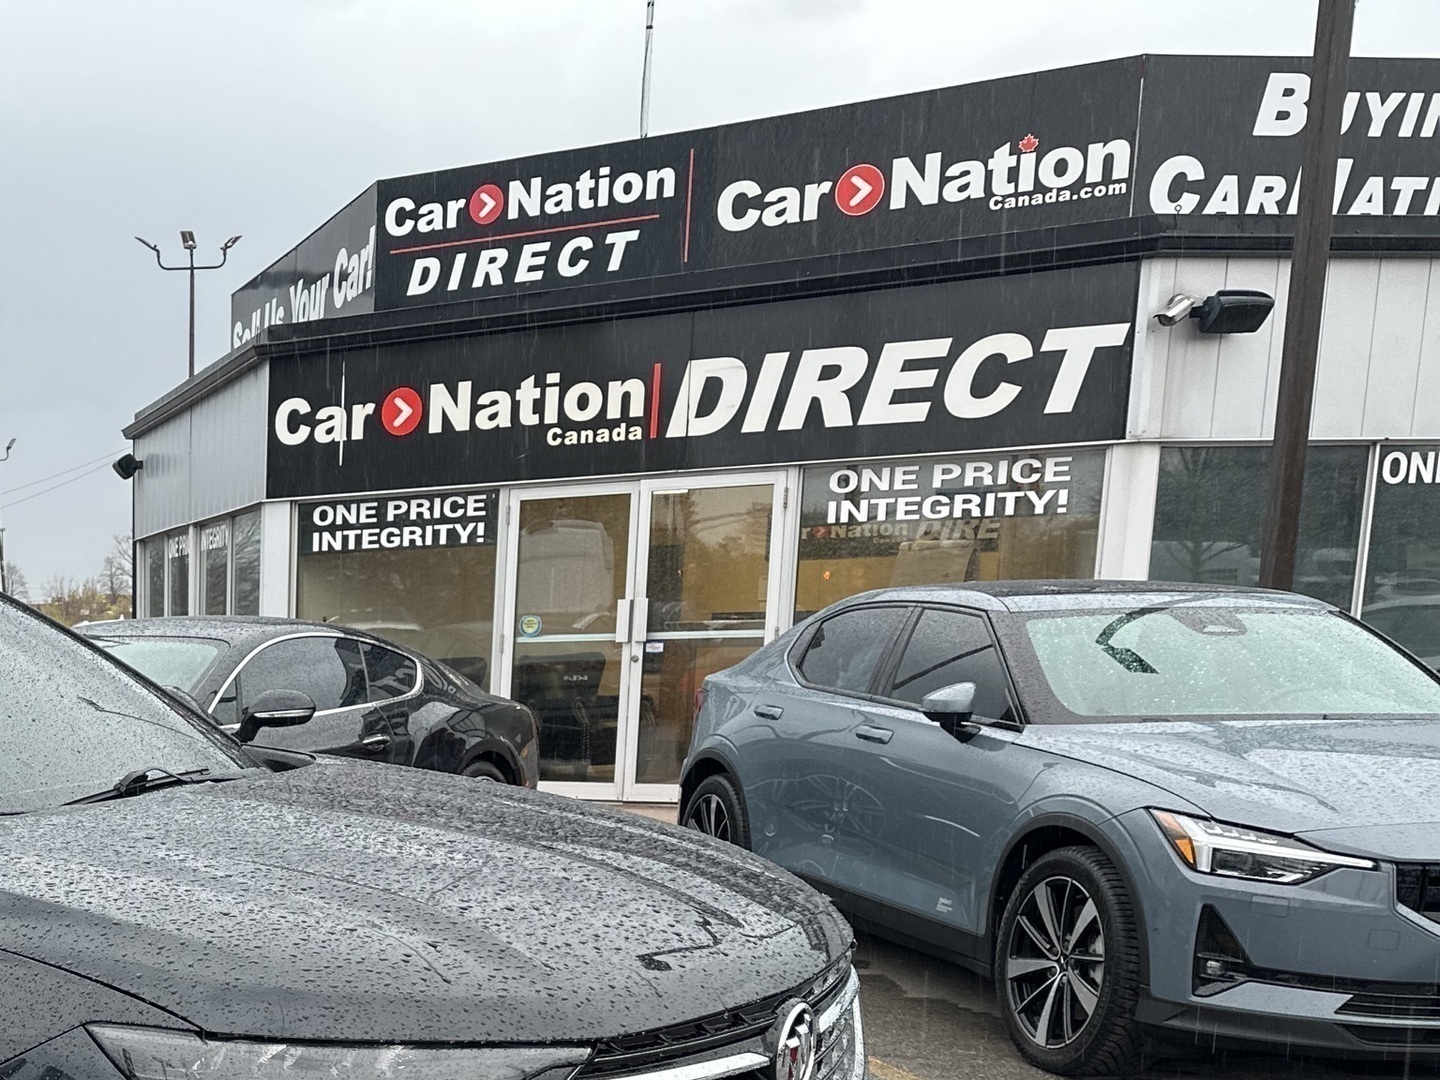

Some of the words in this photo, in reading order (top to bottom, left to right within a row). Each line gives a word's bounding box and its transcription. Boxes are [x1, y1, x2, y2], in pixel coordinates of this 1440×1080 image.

[989, 178, 1128, 211] Canada.com
[289, 273, 330, 323] Your
[333, 225, 376, 309] Car!
[406, 229, 640, 296] DIRECT
[666, 322, 1130, 439] DIRECT
[545, 422, 643, 446] Canada
[828, 465, 920, 494] ONE
[932, 456, 1073, 489] PRICE
[312, 500, 378, 527] ONE
[387, 493, 486, 522] PRICE
[827, 489, 1069, 524] INTEGRITY!
[312, 521, 485, 552] INTEGRITY!
